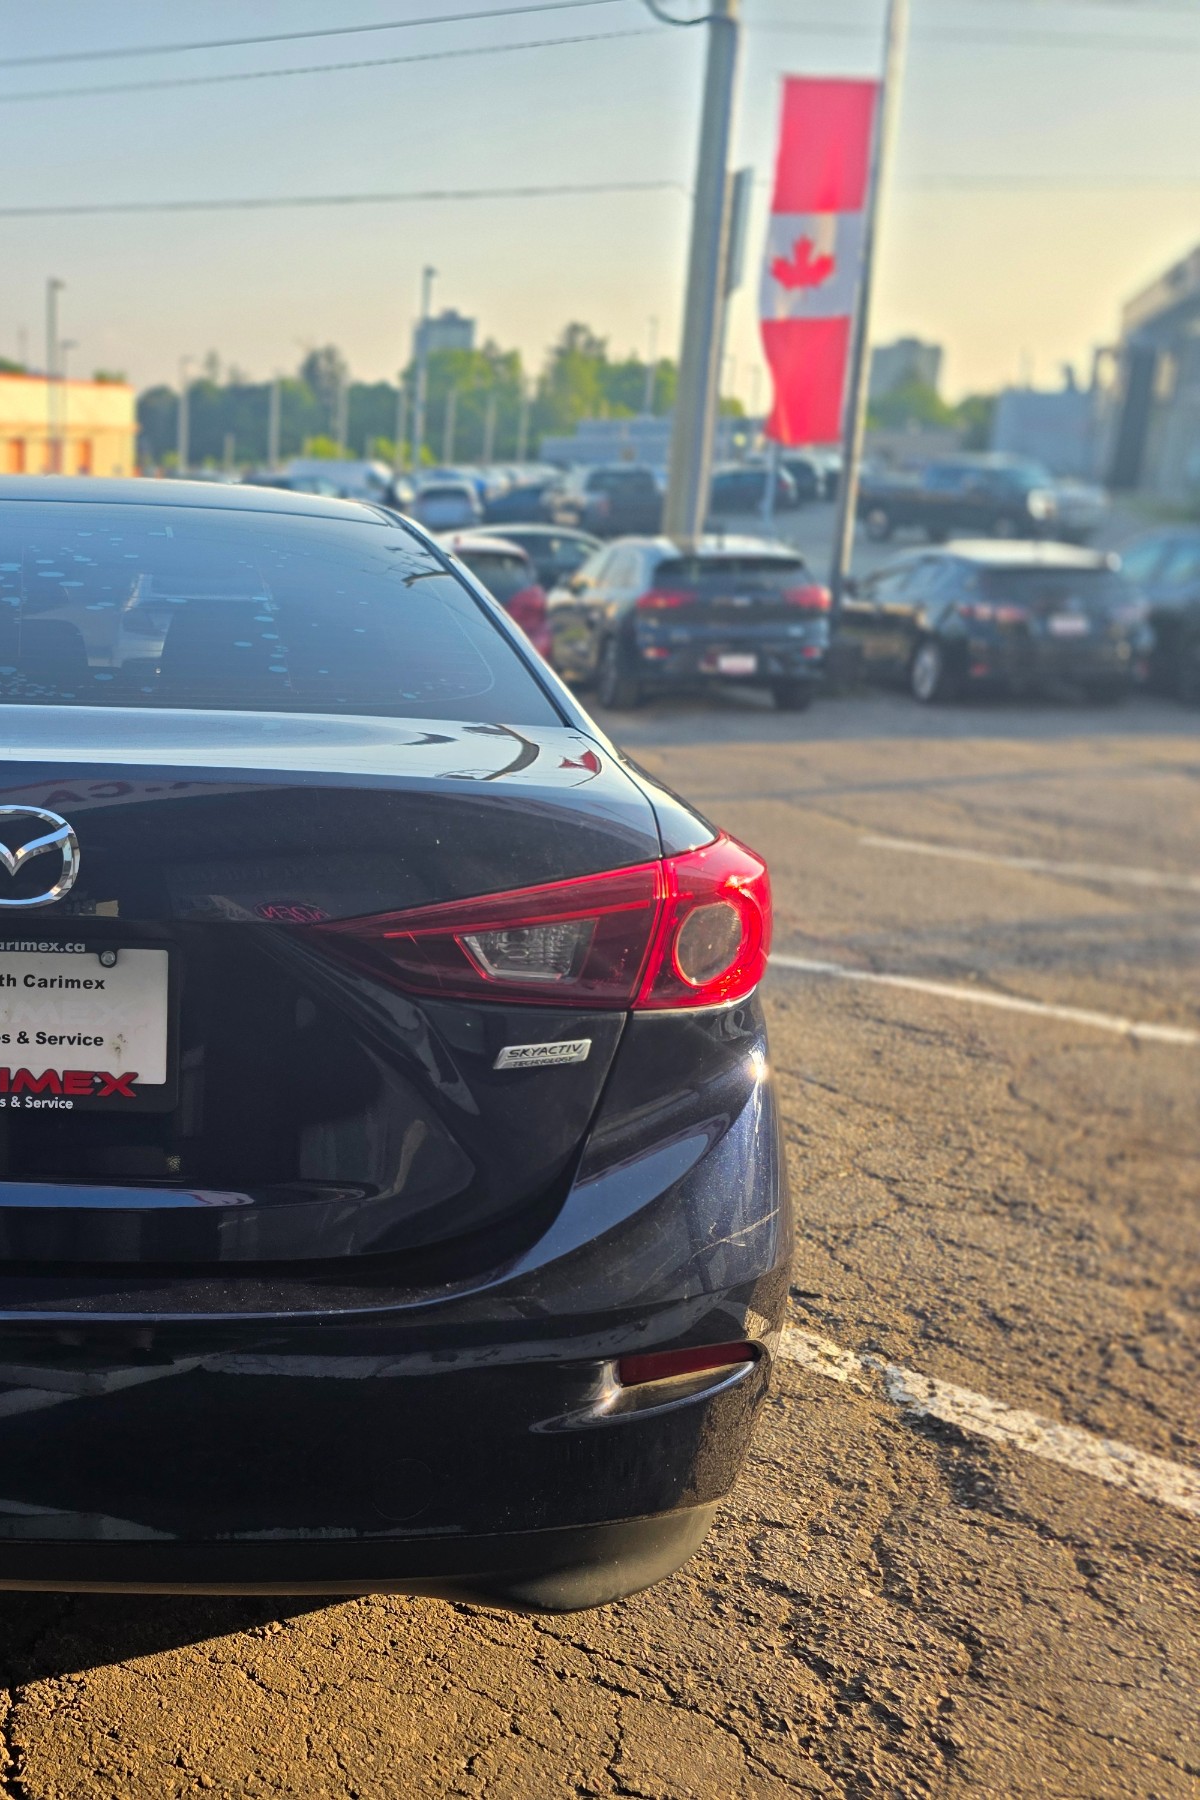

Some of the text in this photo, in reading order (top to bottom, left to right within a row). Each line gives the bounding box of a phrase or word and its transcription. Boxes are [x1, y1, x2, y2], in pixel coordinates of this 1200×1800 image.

[23, 974, 106, 990] Carimex
[17, 1031, 29, 1044] &
[35, 1032, 104, 1047] Service
[507, 1044, 582, 1058] SKYACTIV
[11, 1096, 21, 1108] &
[25, 1097, 74, 1109] Service
